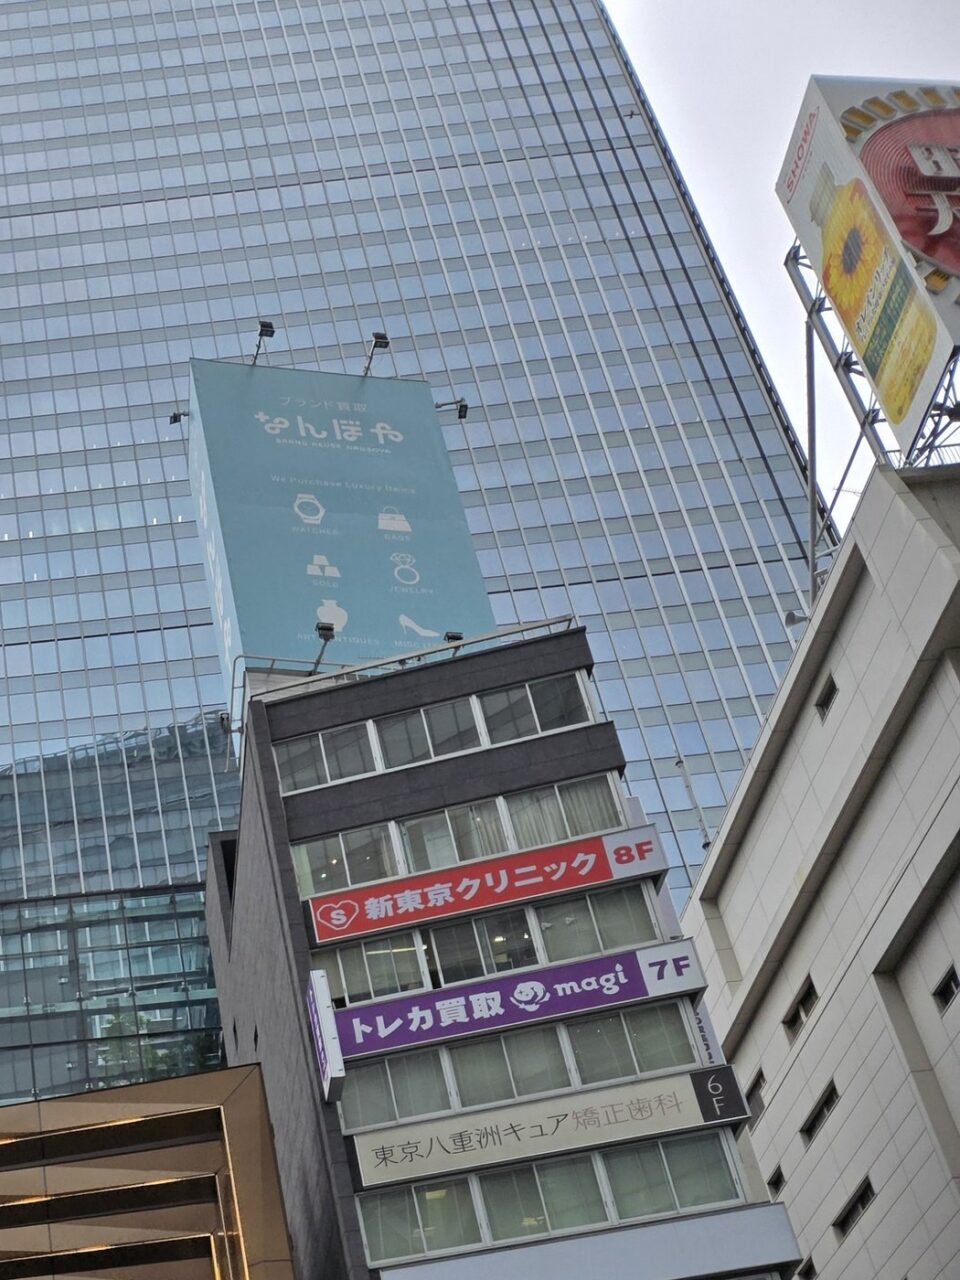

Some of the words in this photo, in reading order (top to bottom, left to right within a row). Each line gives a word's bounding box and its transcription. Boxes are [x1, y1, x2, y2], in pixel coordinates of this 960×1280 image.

[785, 111, 817, 194] SHOWA
[254, 411, 404, 444] なんぼや
[364, 847, 598, 920] 新東京クリニック
[613, 840, 655, 865] 8F
[351, 990, 505, 1044] トレカ買取
[553, 963, 629, 997] magi
[648, 956, 692, 981] 7F
[371, 1091, 683, 1169] 東京八重洲キュア矯正歯科
[706, 1074, 725, 1117] 6F
